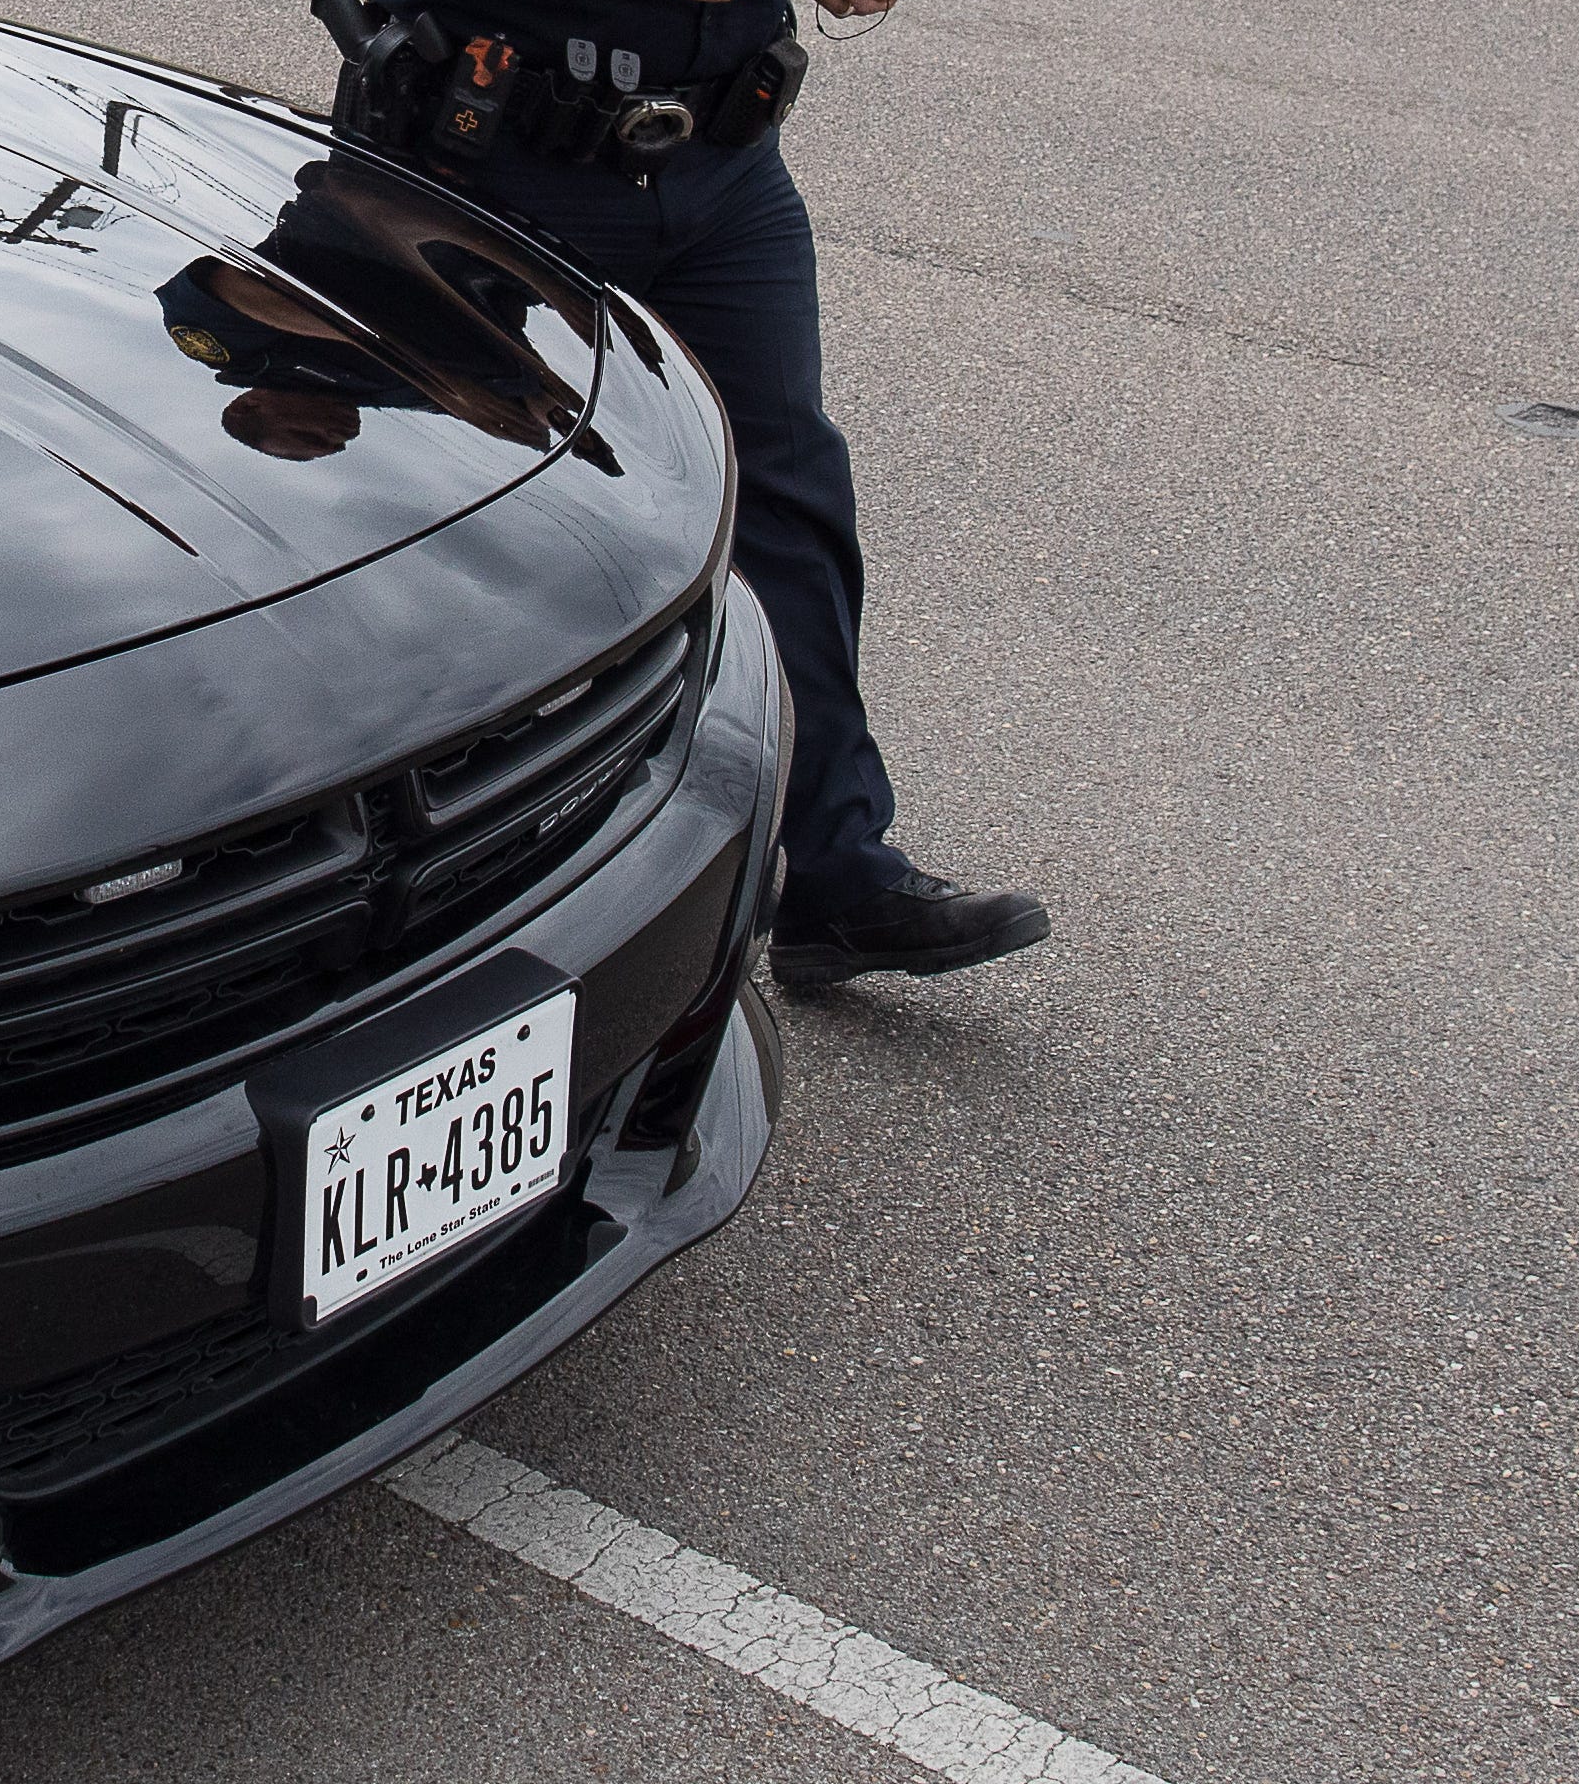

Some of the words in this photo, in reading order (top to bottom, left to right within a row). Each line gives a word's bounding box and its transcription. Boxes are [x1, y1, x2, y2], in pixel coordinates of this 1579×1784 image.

[395, 1047, 496, 1127] TEXAS
[379, 1250, 404, 1269] The
[407, 1232, 437, 1256] Lone
[440, 1215, 466, 1236] Star
[469, 1197, 501, 1220] State
